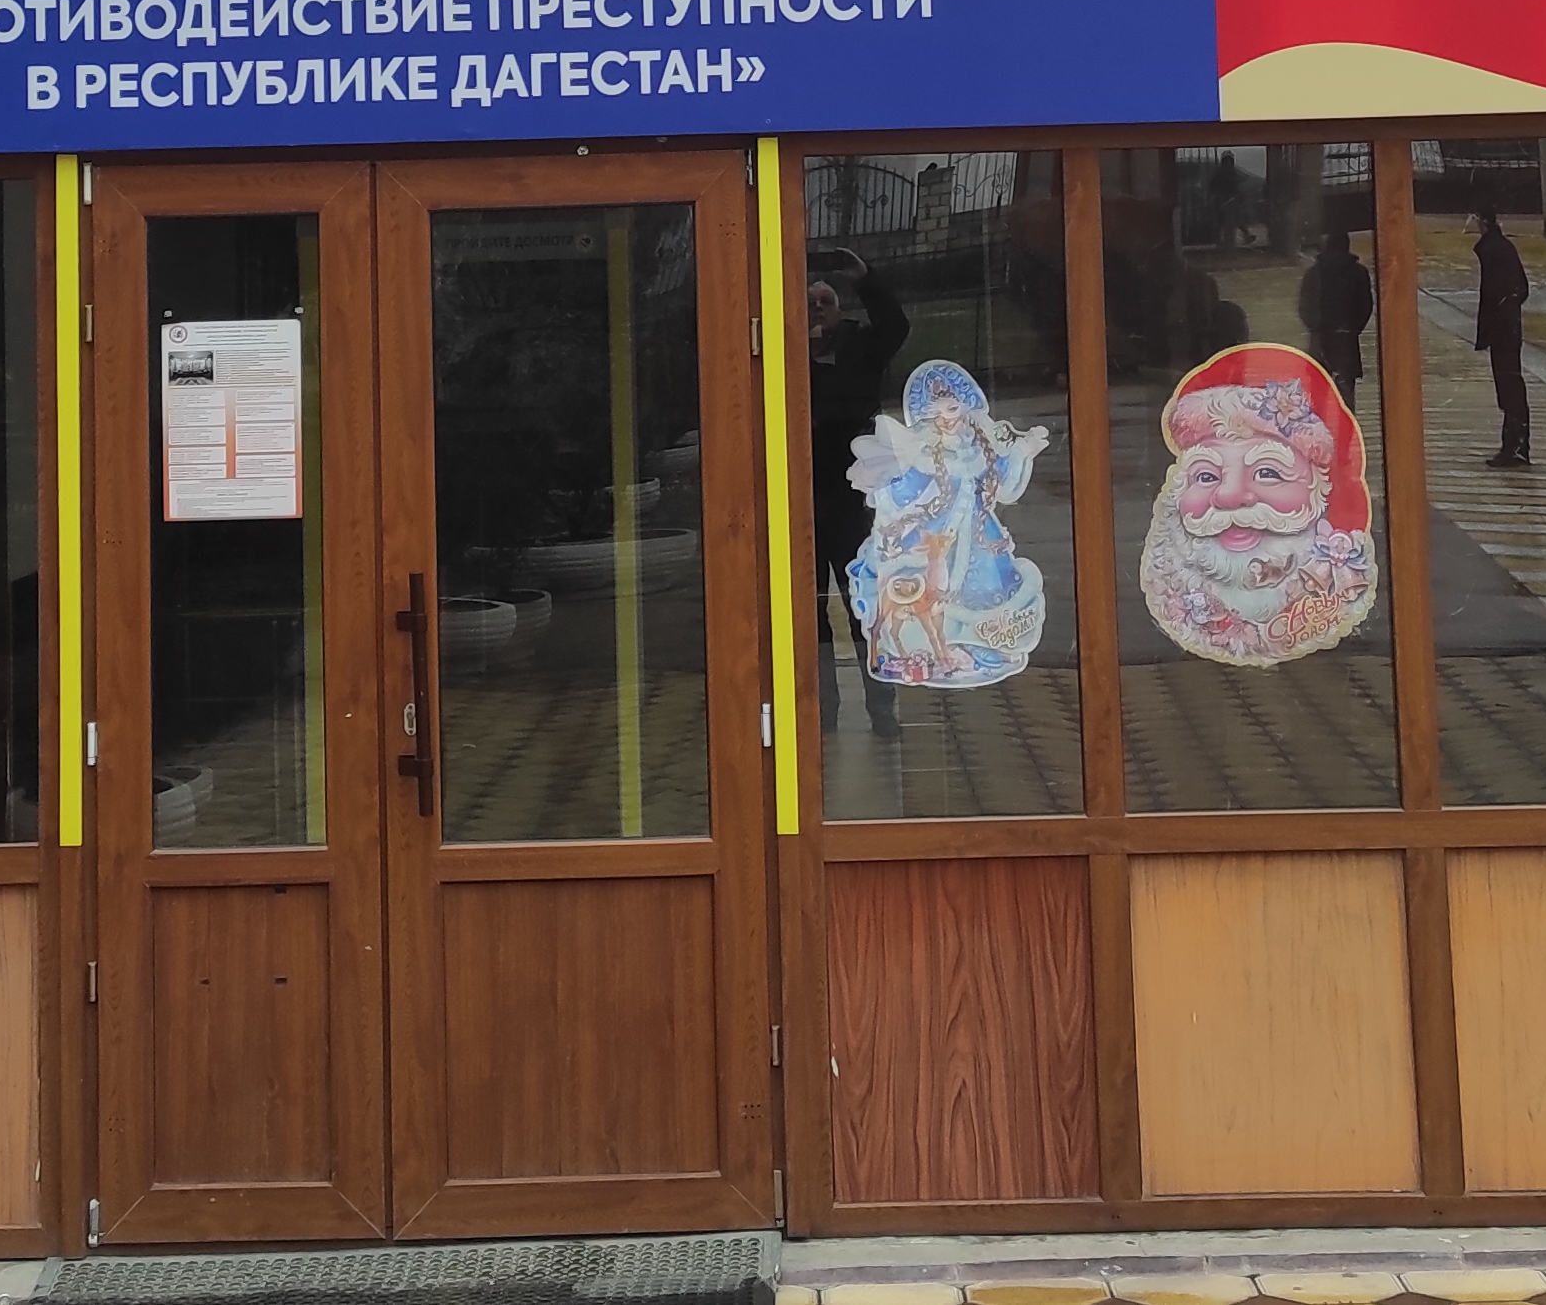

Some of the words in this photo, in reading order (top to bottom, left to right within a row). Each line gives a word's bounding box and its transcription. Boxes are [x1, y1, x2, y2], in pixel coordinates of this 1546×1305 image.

[26, 65, 61, 111] В
[75, 55, 438, 110] РЕСПУБЛИКЕ
[450, 48, 766, 108] ДАГЕСТАН»
